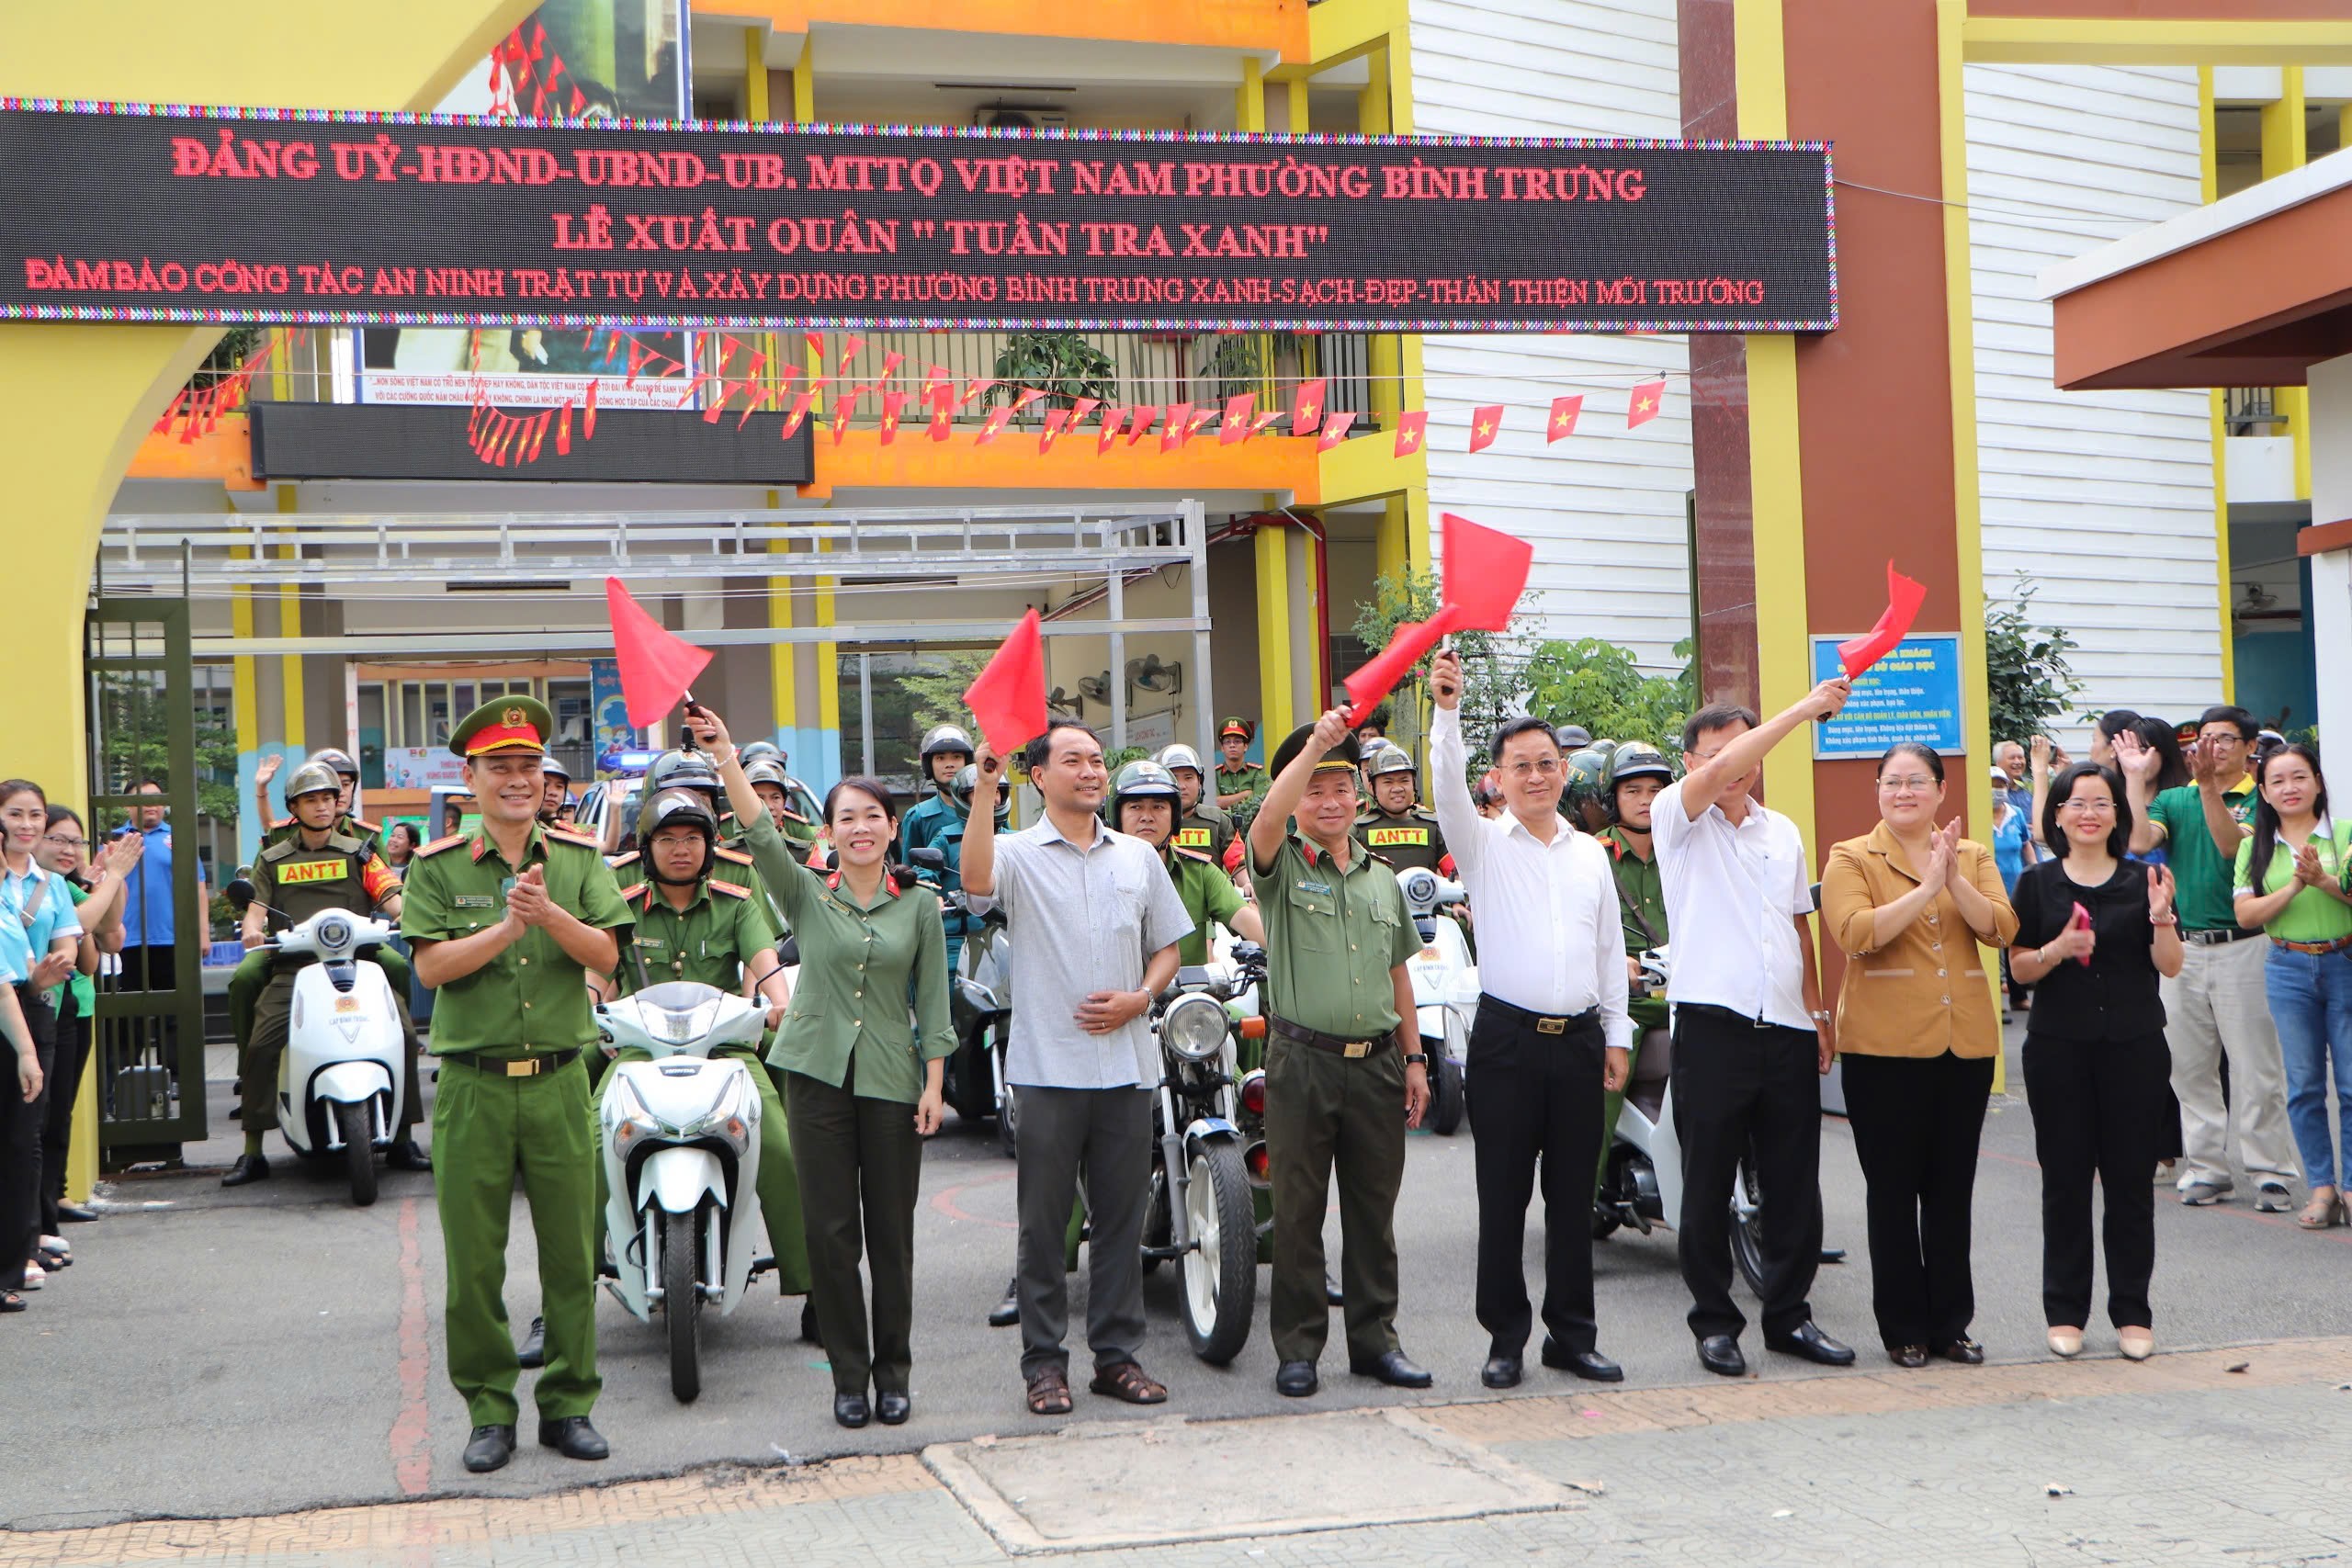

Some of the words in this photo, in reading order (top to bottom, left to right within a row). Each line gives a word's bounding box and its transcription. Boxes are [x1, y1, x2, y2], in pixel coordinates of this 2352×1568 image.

[171, 128, 321, 179] ĐẢNG
[805, 154, 944, 197] MTTQ
[952, 154, 1059, 198] VIỆT
[1070, 161, 1176, 197] NAM
[1182, 154, 1372, 198] PHƯỜNG
[1381, 156, 1488, 200] BÌNH
[1494, 164, 1646, 202] TRƯNG
[551, 204, 614, 250] LỄ
[767, 209, 900, 256] QUÂN
[1080, 222, 1174, 258] TRA
[1181, 223, 1329, 258] XANH"
[297, 261, 365, 295] TÁC
[371, 267, 417, 296] AN
[424, 267, 505, 297] NINH
[512, 267, 597, 301] TRẬT
[600, 269, 649, 303] TỰ
[704, 268, 773, 299] XÂY
[777, 271, 868, 305] DỰNG
[1005, 272, 1079, 302] BÌNH
[1508, 276, 1589, 309] THIỆN
[1595, 276, 1646, 305] MÔI
[1170, 830, 1204, 844] NTT
[1374, 830, 1422, 843] ANTT
[286, 862, 340, 882] ANTT
